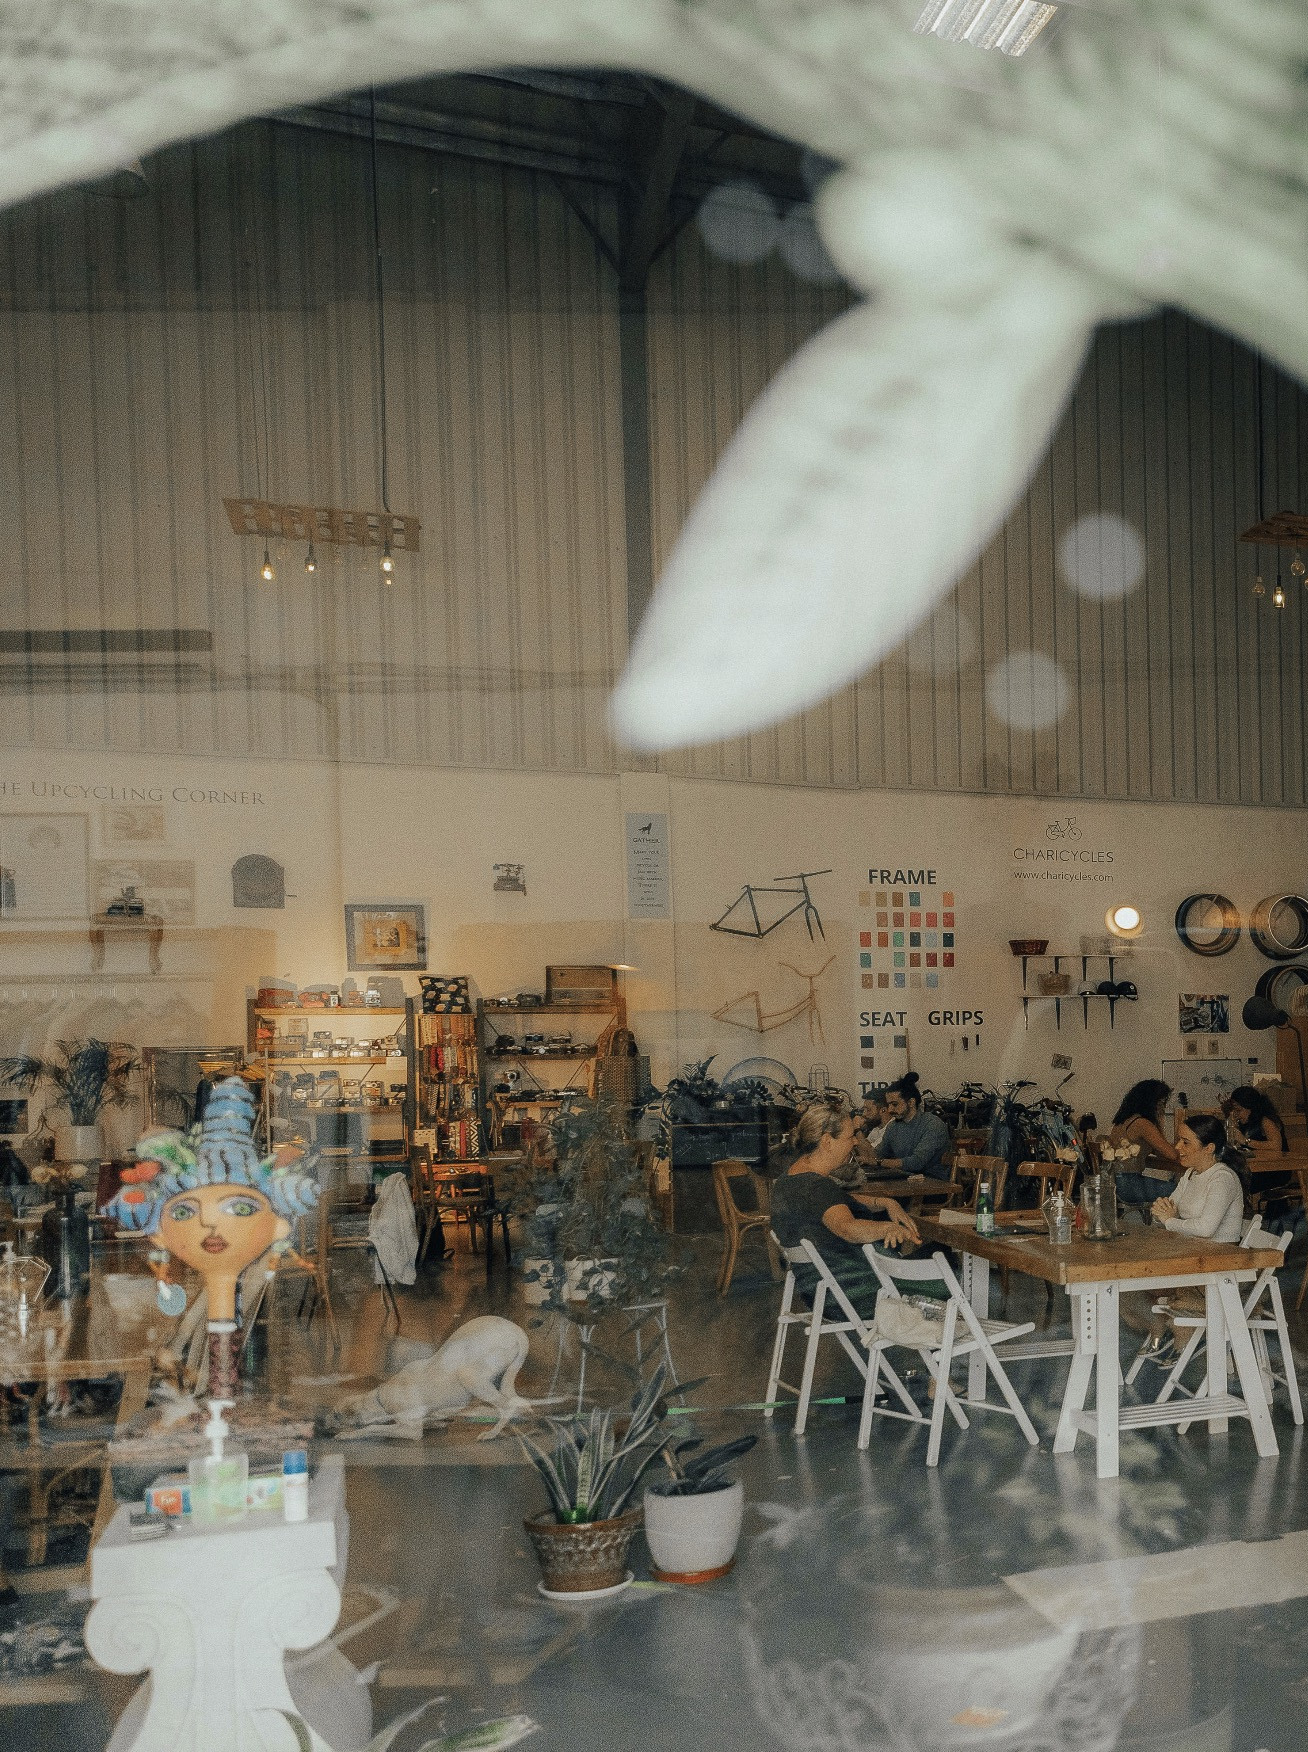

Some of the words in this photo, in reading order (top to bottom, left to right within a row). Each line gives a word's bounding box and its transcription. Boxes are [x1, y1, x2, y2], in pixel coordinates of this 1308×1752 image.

[31, 781, 163, 802] UPCYCLING
[172, 787, 265, 805] CORNER
[1013, 848, 1114, 863] CHARICYCLES
[868, 869, 937, 885] FRAME
[1014, 871, 1114, 883] www.charicycles.com
[860, 1011, 908, 1027] SEAT
[928, 1010, 984, 1026] GRIPS
